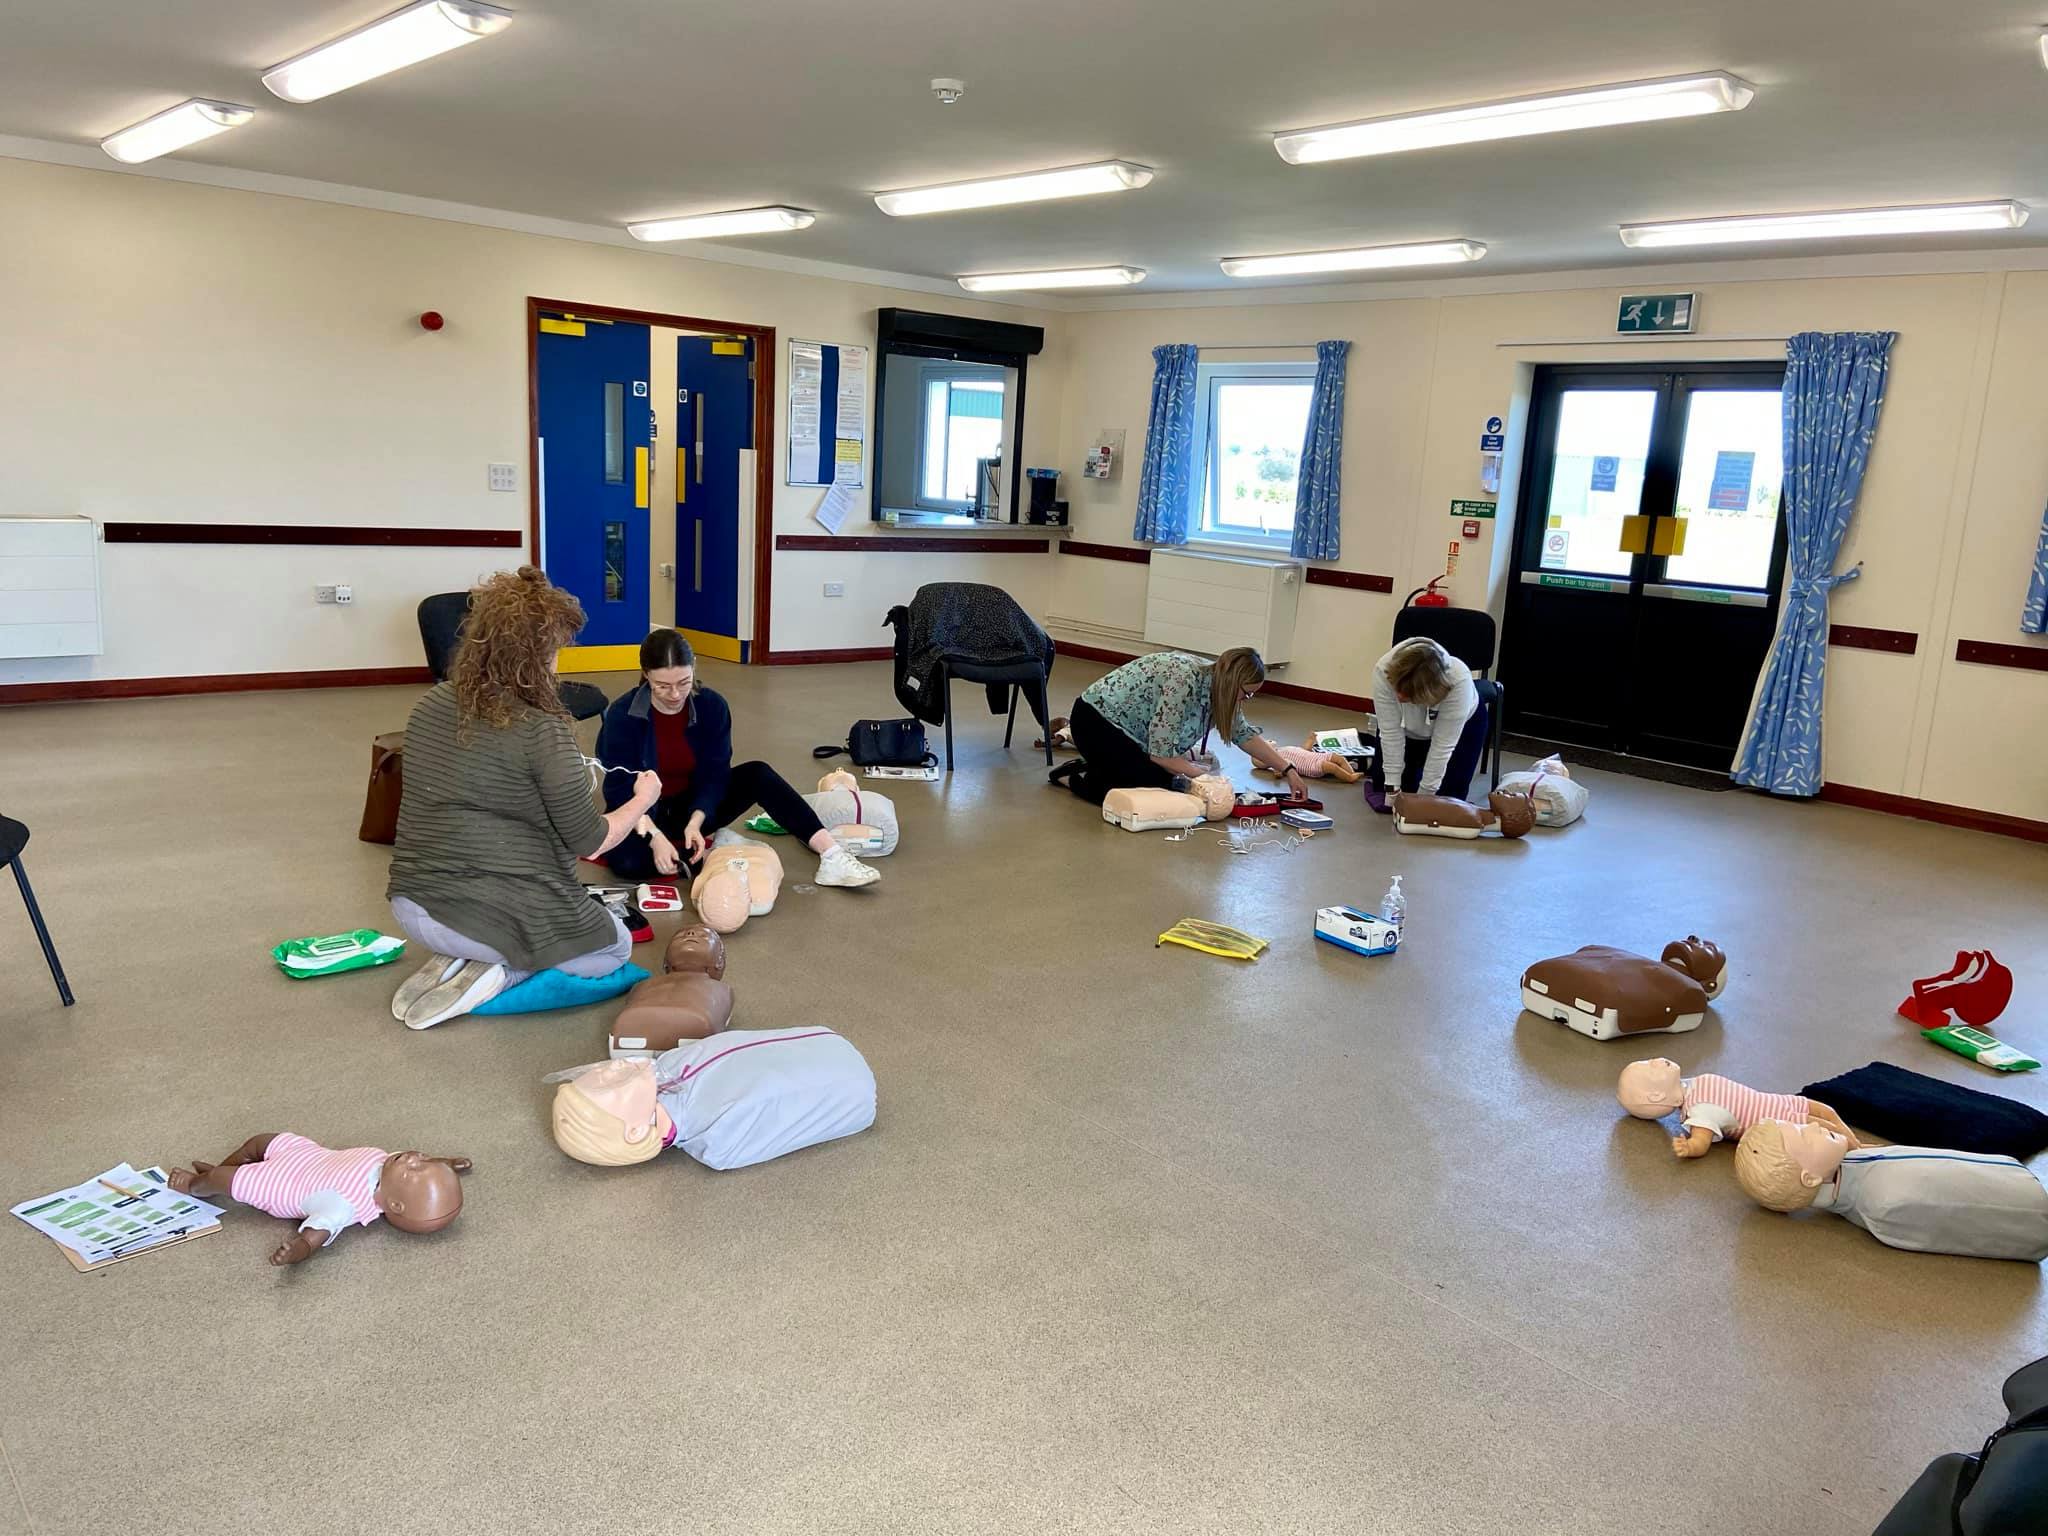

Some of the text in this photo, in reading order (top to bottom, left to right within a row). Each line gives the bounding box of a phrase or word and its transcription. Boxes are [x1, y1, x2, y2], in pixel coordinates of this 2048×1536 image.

[1546, 576, 1564, 584] Push
[1565, 577, 1577, 585] bar
[1586, 581, 1605, 589] open
